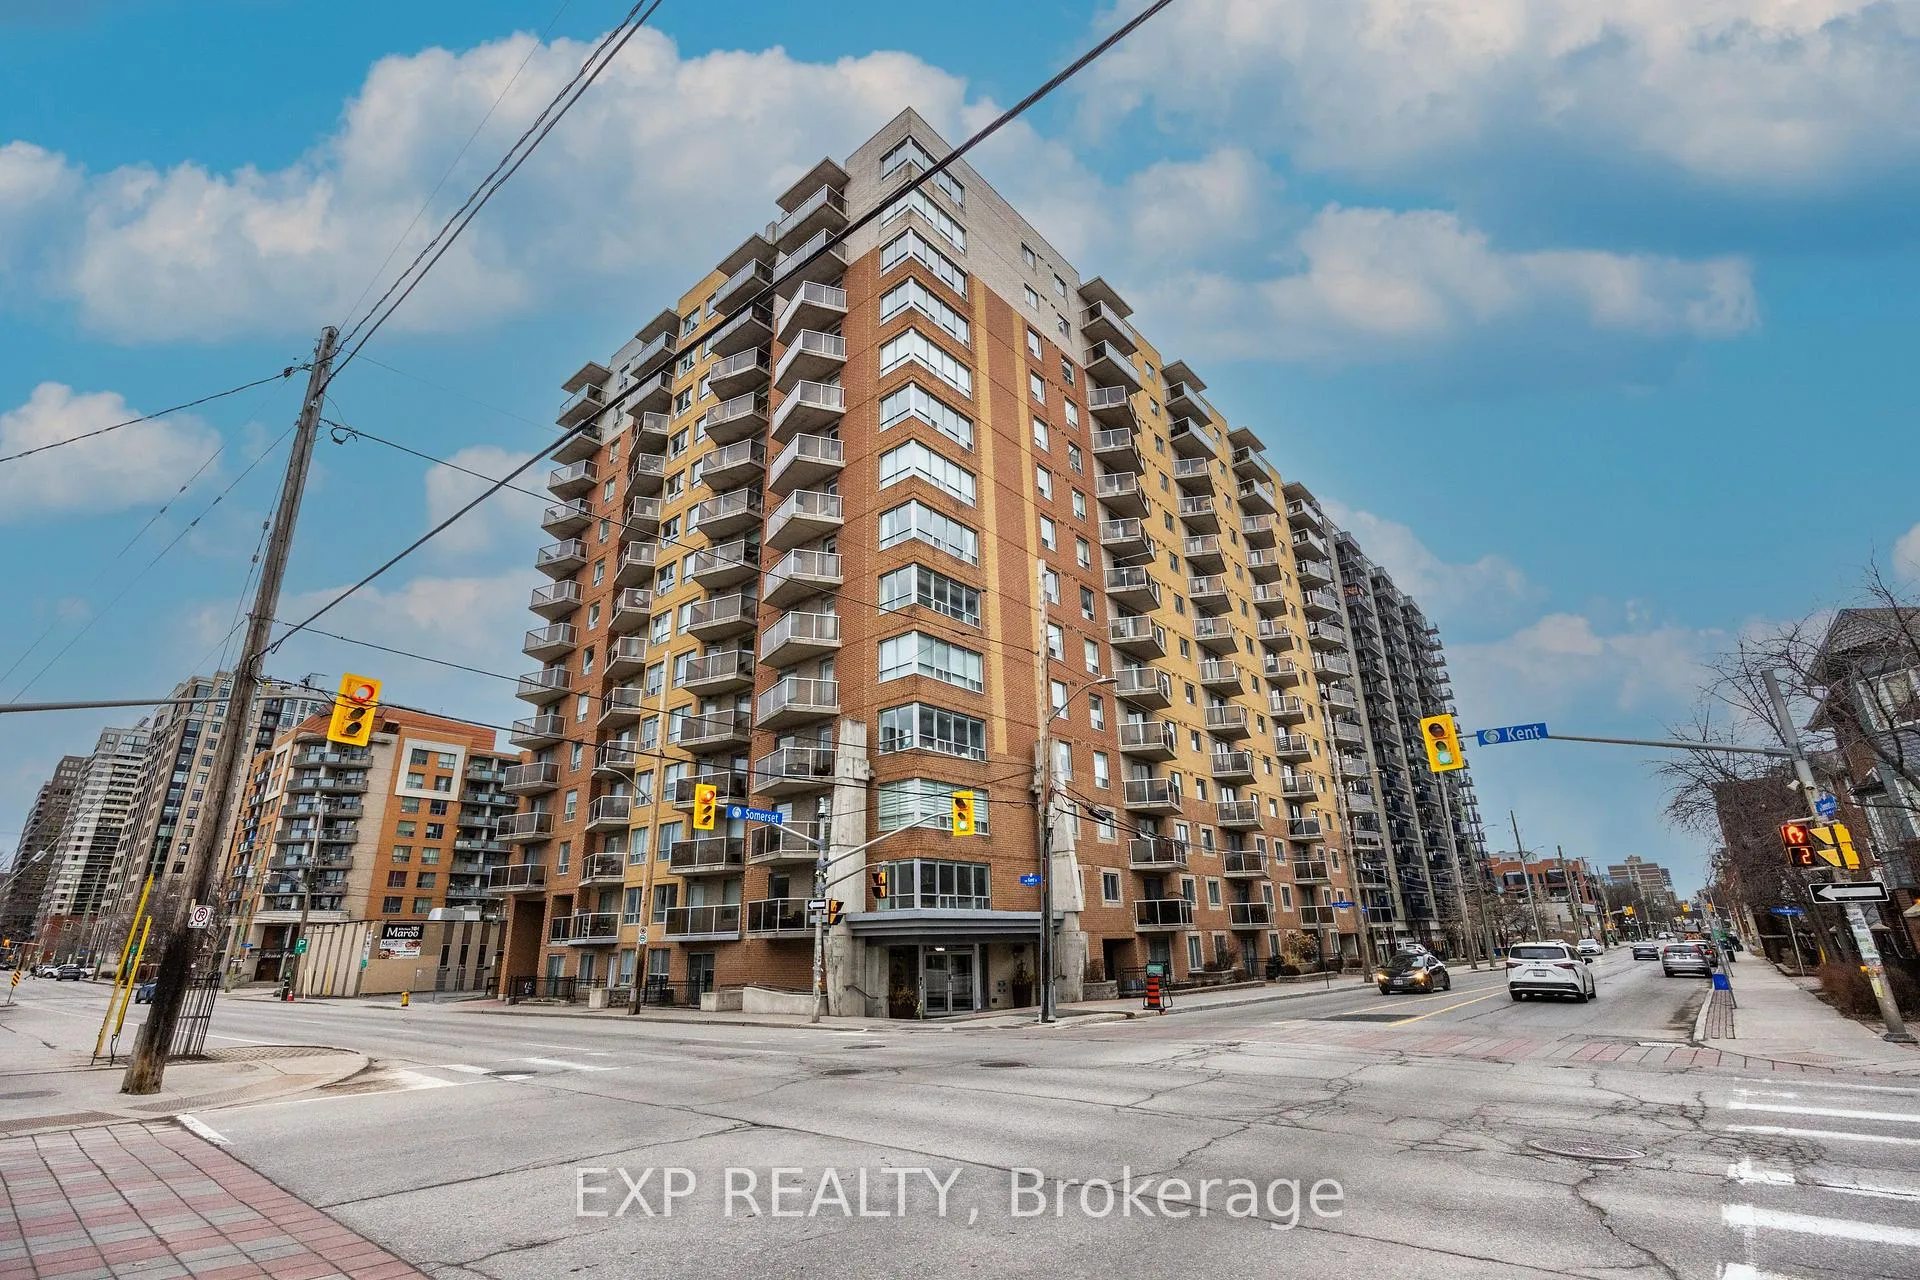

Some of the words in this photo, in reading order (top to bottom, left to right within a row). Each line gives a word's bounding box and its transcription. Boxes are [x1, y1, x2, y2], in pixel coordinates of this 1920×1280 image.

[1506, 725, 1541, 741] Kent
[745, 808, 779, 823] Somerset
[1800, 848, 1812, 864] 2
[386, 927, 419, 937] Maroo
